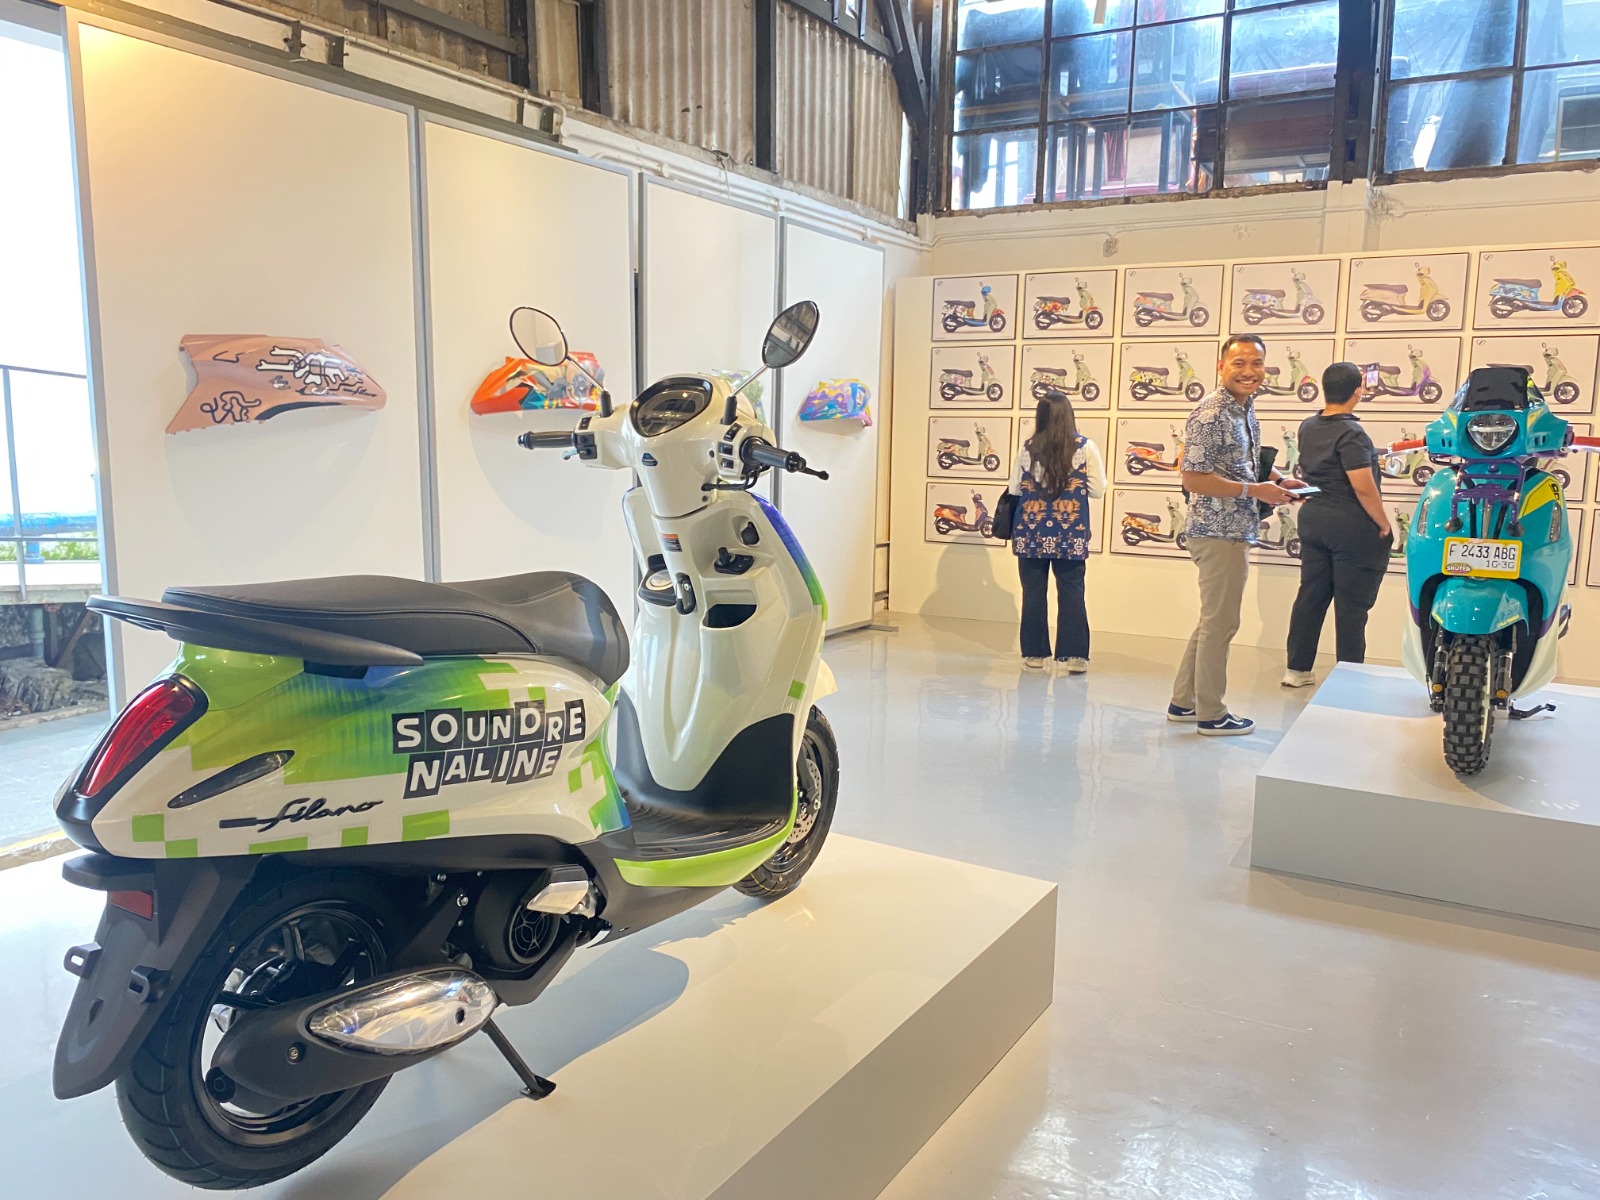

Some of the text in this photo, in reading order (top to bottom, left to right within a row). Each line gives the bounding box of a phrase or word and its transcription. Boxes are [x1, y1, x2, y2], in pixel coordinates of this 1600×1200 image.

[1449, 544, 1516, 560] F 2433 ABG
[396, 706, 583, 749] SOUNDRE
[409, 748, 559, 792] NALINE
